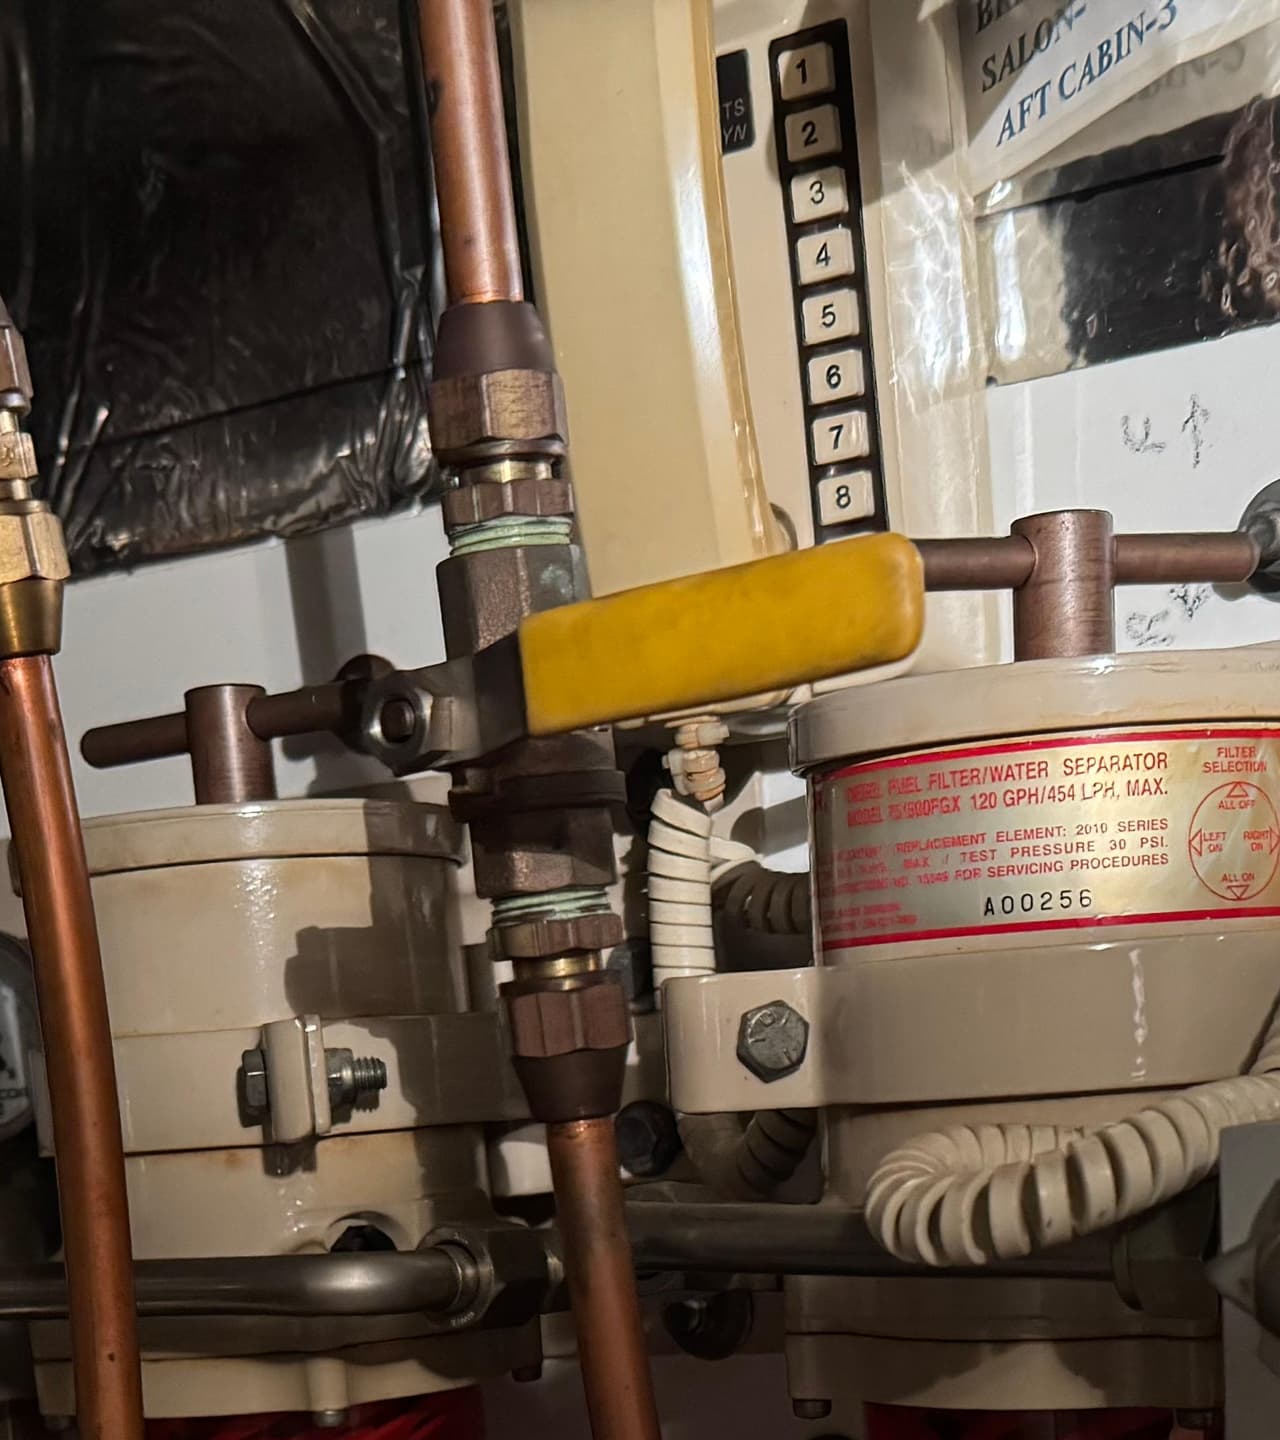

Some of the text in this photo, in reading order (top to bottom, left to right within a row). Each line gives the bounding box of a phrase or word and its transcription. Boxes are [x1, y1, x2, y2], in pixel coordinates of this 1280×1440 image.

[796, 58, 808, 85] 1
[996, 80, 1051, 147] AFT
[1058, 0, 1177, 101] CABIN-3
[801, 121, 818, 147] 2
[809, 180, 825, 205] 3
[815, 242, 831, 267] 4
[821, 304, 836, 328] 5
[826, 365, 841, 389] 6
[829, 425, 844, 450] 7
[836, 485, 851, 509] 8
[1217, 746, 1257, 758] FILTER
[929, 761, 1049, 790] FILTER/WATER
[1063, 752, 1168, 777] SEPARATOR
[1202, 760, 1267, 774] SELECTION
[971, 792, 998, 810] 120
[1003, 784, 1075, 807] GPH/454
[1127, 777, 1168, 797] MAX.
[896, 818, 1168, 853] REPLACEMENT ELEMENT: 2010 SERIES
[960, 849, 997, 863] TEST
[1010, 841, 1096, 859] PRESSURE
[1109, 839, 1127, 851] 30
[1140, 836, 1168, 849] PSI.
[987, 860, 1064, 878] SERVICING
[1070, 853, 1169, 871] PROCEDURES
[984, 889, 1093, 916] A00256
